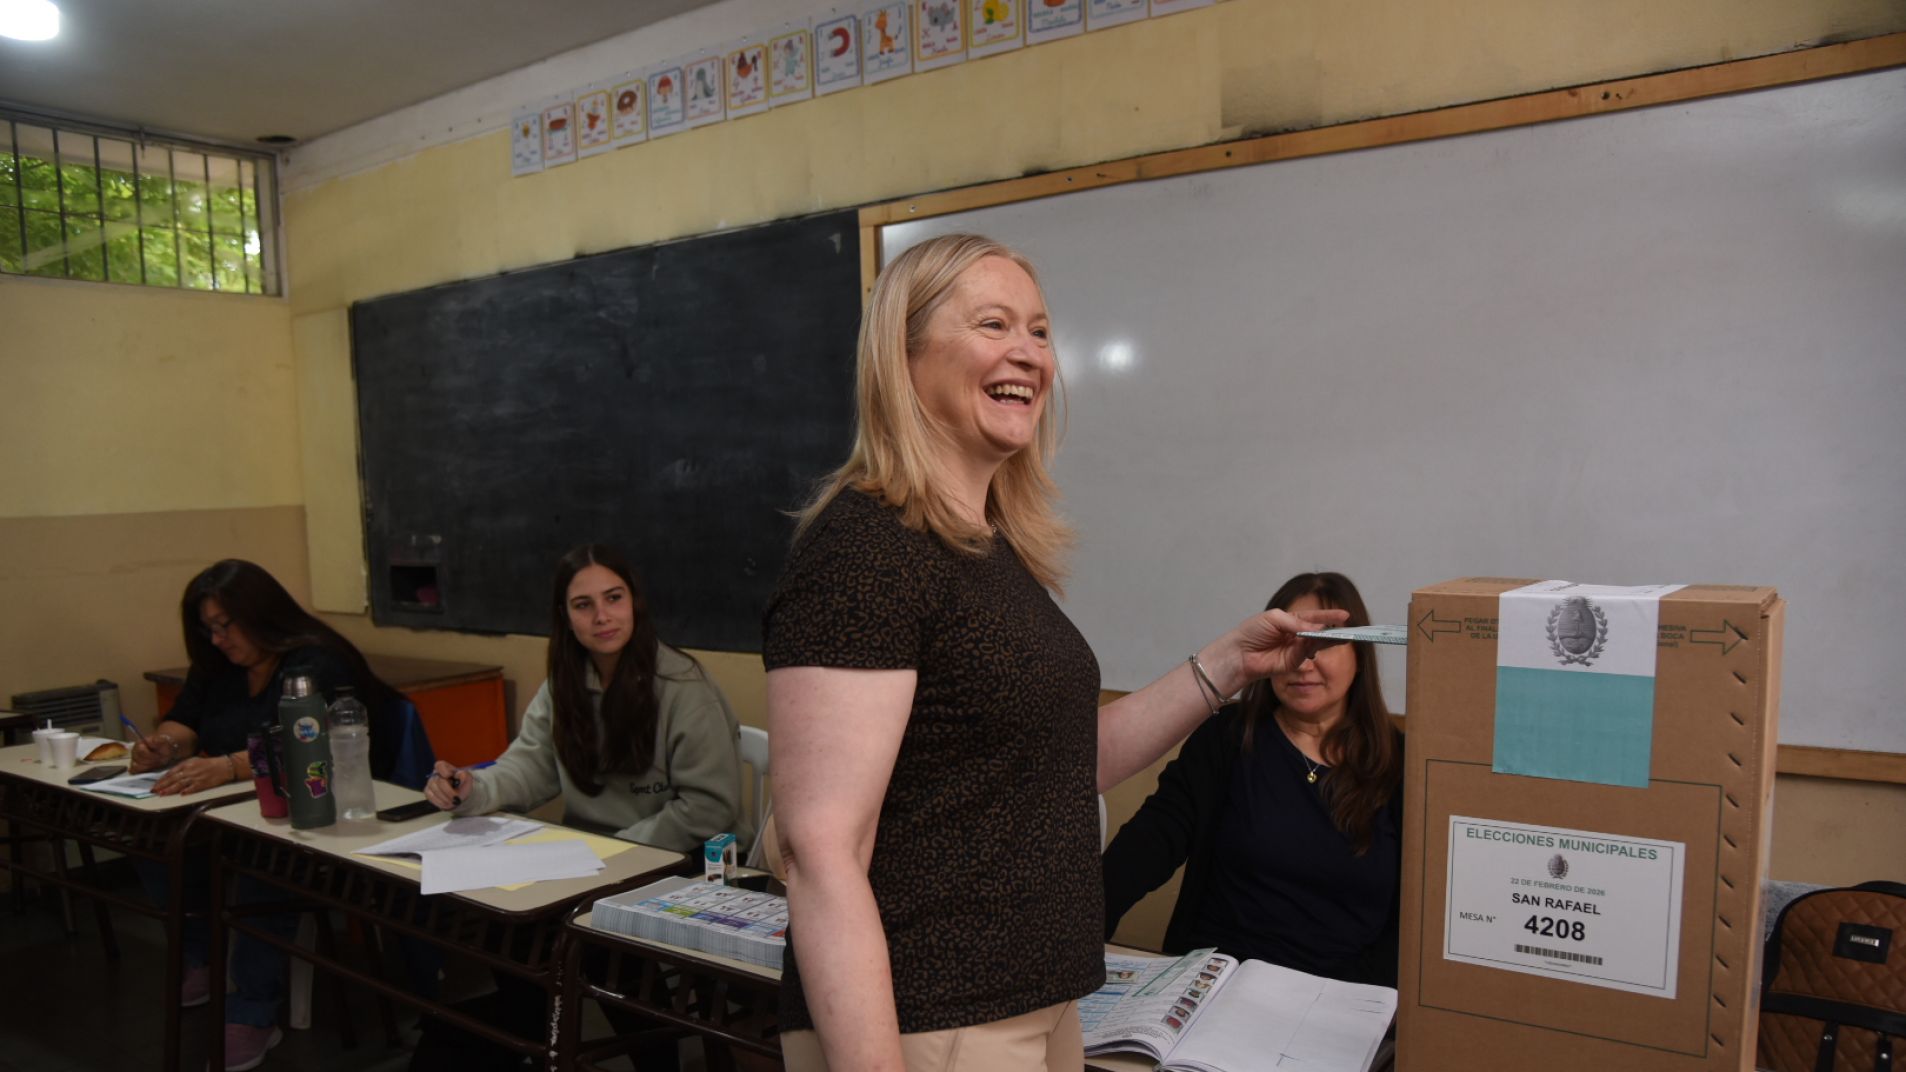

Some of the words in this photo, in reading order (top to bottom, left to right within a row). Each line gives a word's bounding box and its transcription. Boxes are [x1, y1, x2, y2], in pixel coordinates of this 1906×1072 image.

[1466, 827, 1554, 848] ELECCIONES
[1558, 838, 1658, 860] MUNICIPALES
[1510, 877, 1519, 885] 22
[1521, 878, 1532, 887] DE
[1533, 880, 1573, 893] FEBRERO
[1573, 886, 1585, 894] DE
[1587, 887, 1606, 897] 2026
[1511, 892, 1541, 907] SAN
[1544, 897, 1601, 915] RAFAEL
[1459, 911, 1484, 922] MESA
[1524, 914, 1586, 941] 4208
